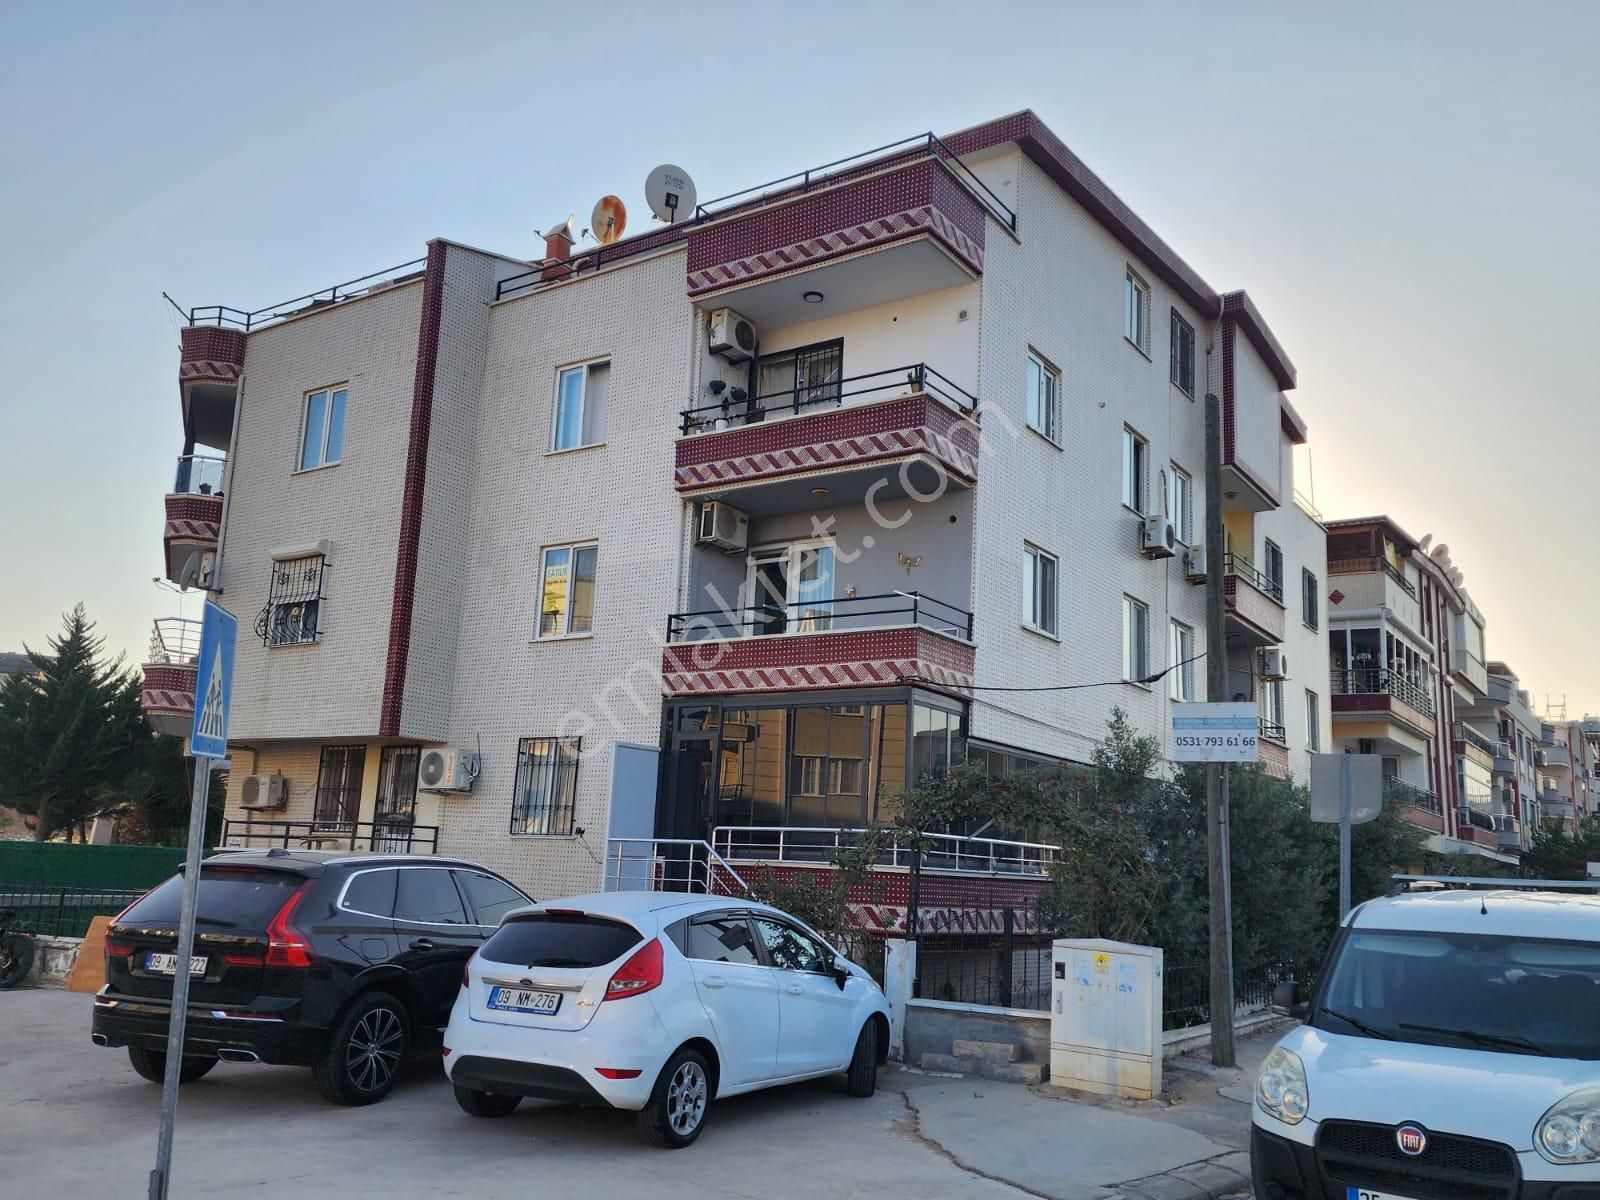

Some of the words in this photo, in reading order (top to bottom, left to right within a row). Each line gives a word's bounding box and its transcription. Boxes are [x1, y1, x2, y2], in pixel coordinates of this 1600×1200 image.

[1176, 736, 1201, 746] 0531
[1204, 736, 1224, 746] 793
[1226, 736, 1240, 746] 61
[1242, 736, 1256, 746] 66
[497, 990, 511, 1004] 09
[516, 991, 531, 1007] NM
[535, 994, 555, 1008] 276
[1403, 1134, 1420, 1148] FIAT
